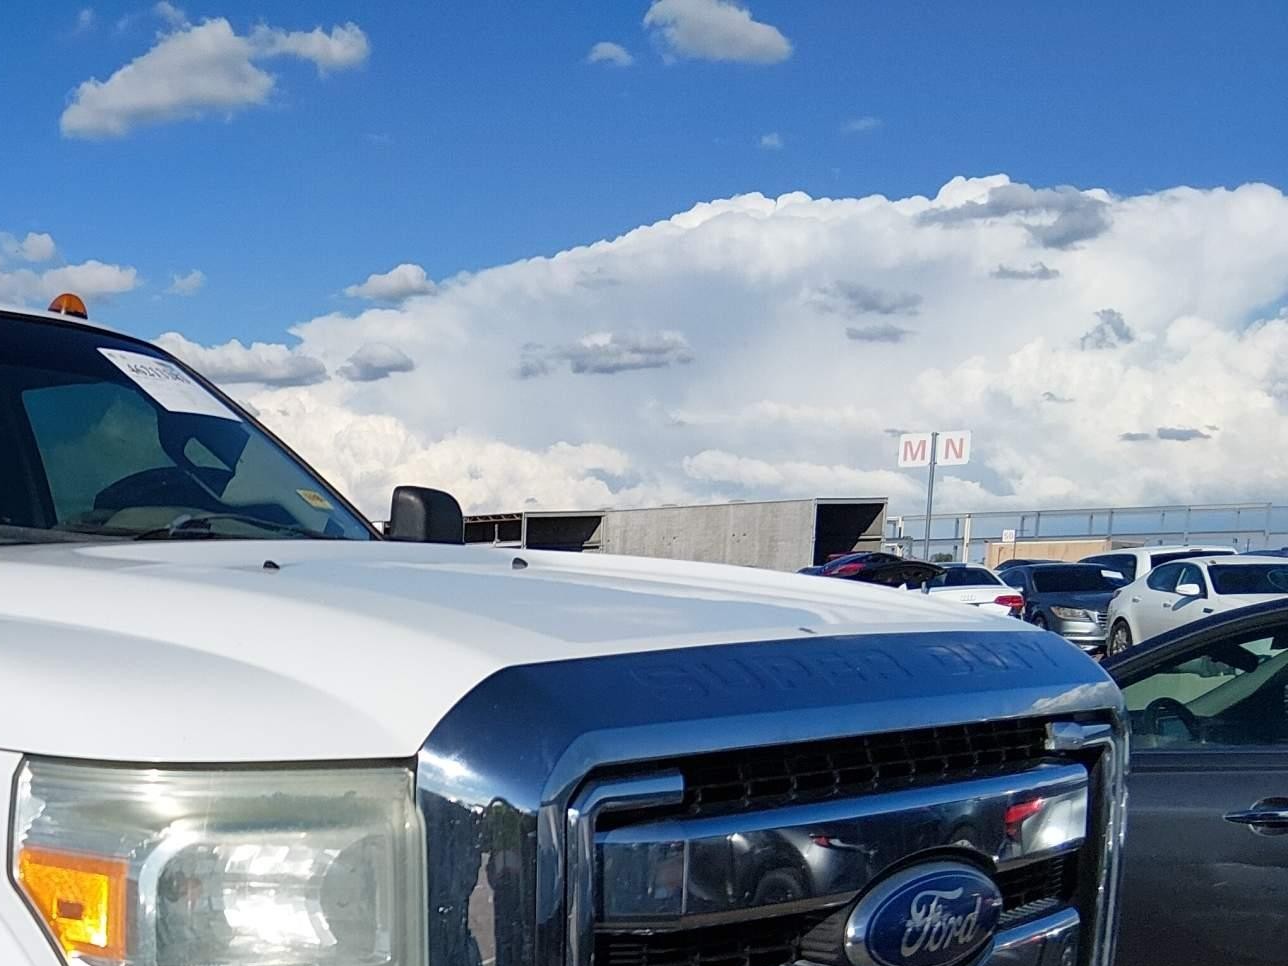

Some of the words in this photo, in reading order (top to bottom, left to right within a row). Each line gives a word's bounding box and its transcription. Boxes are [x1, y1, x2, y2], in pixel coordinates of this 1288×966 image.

[903, 440, 927, 461] M
[944, 438, 964, 459] N
[901, 887, 983, 957] Ford
